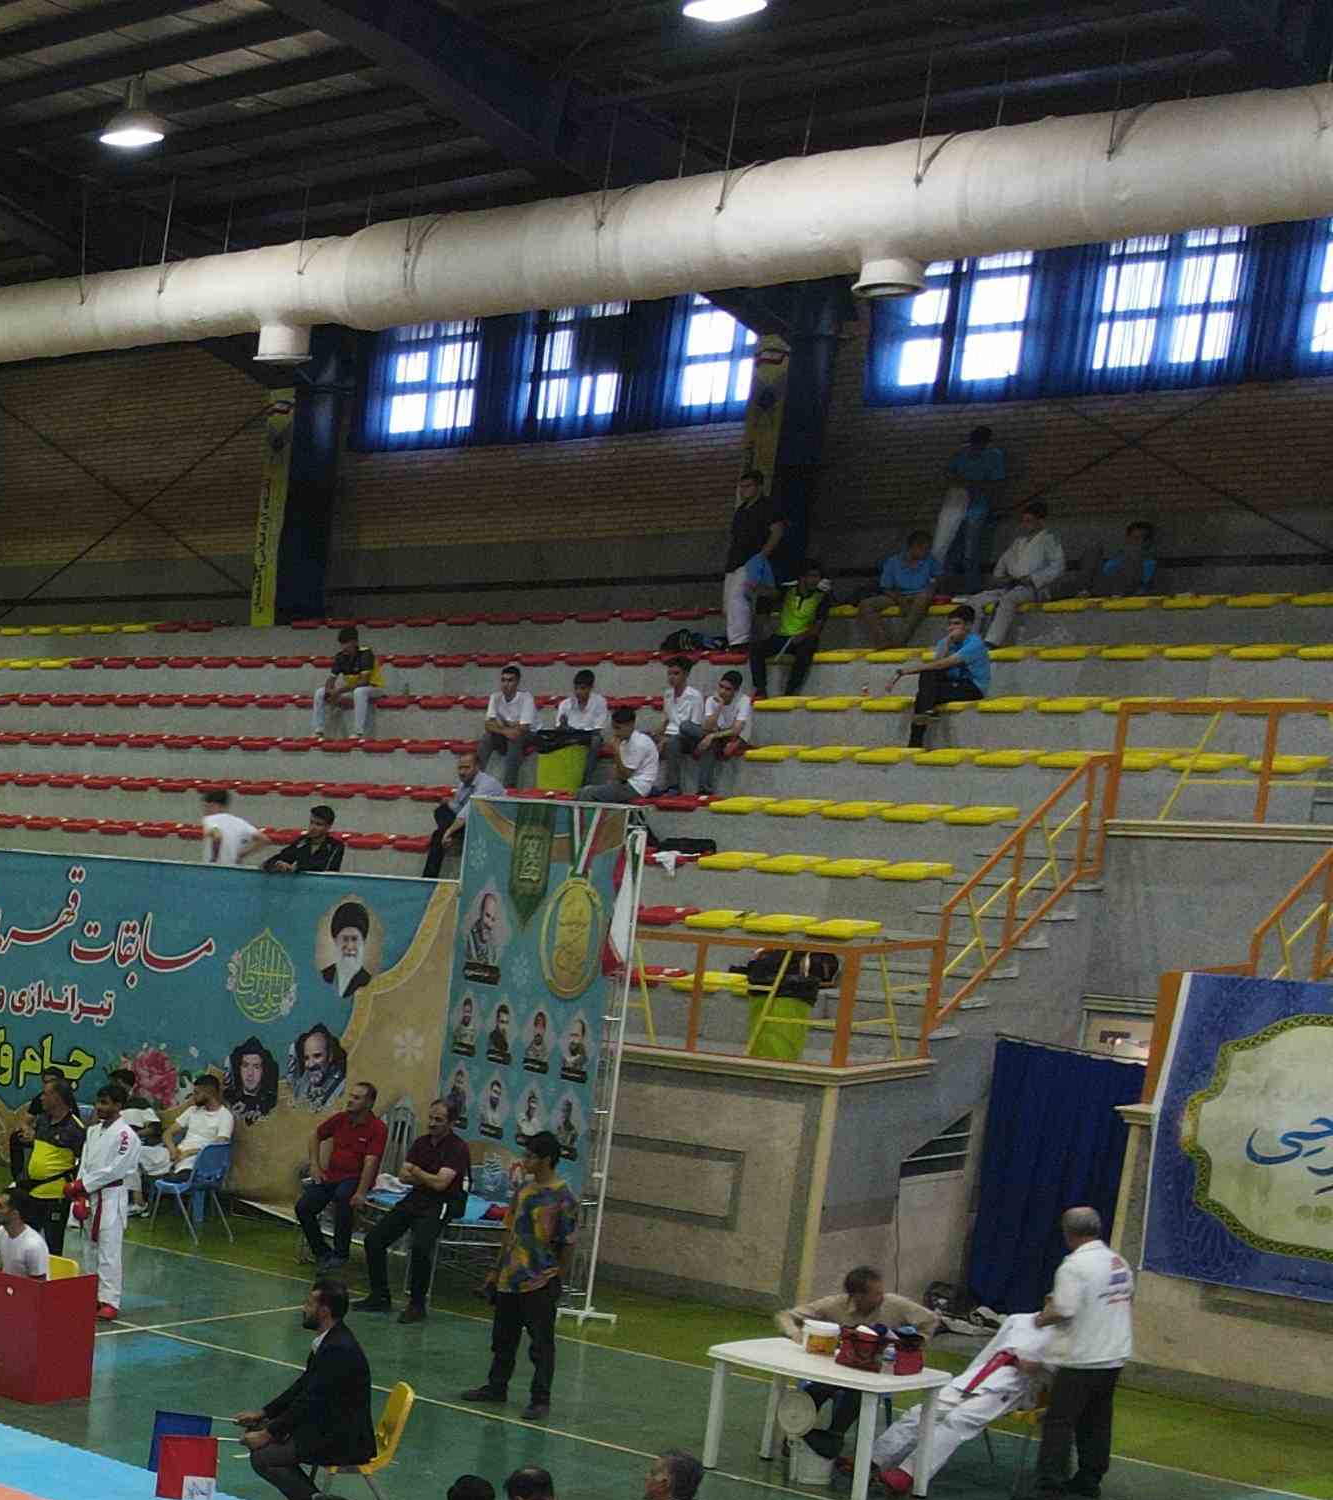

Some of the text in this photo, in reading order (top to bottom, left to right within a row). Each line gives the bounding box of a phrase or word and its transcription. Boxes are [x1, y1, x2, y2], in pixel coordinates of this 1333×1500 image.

[70, 912, 216, 988] مسابقات
[9, 981, 116, 1028] تیراندازی
[18, 1034, 96, 1090] جام
